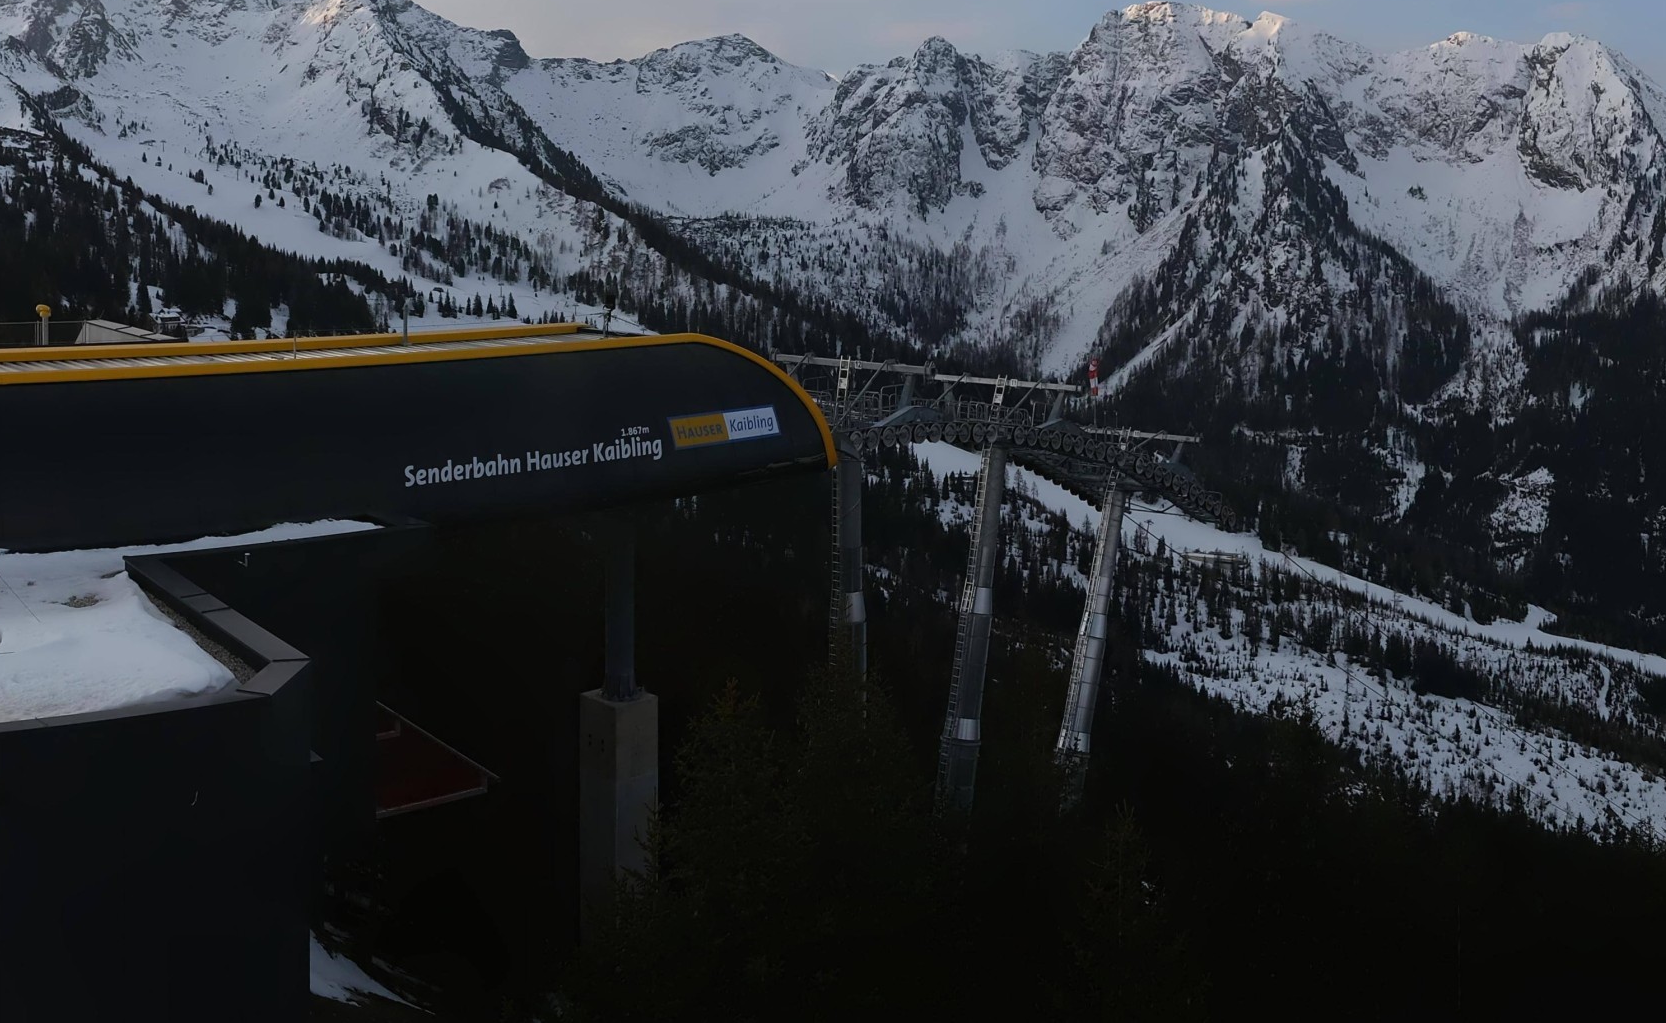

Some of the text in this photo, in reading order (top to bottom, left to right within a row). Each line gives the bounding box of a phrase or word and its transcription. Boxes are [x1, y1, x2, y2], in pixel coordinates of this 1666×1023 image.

[621, 426, 650, 437] 1.867m
[676, 415, 773, 439] HAUSER Kaibling
[404, 437, 663, 487] Senderbahn Hauser Kaibling
